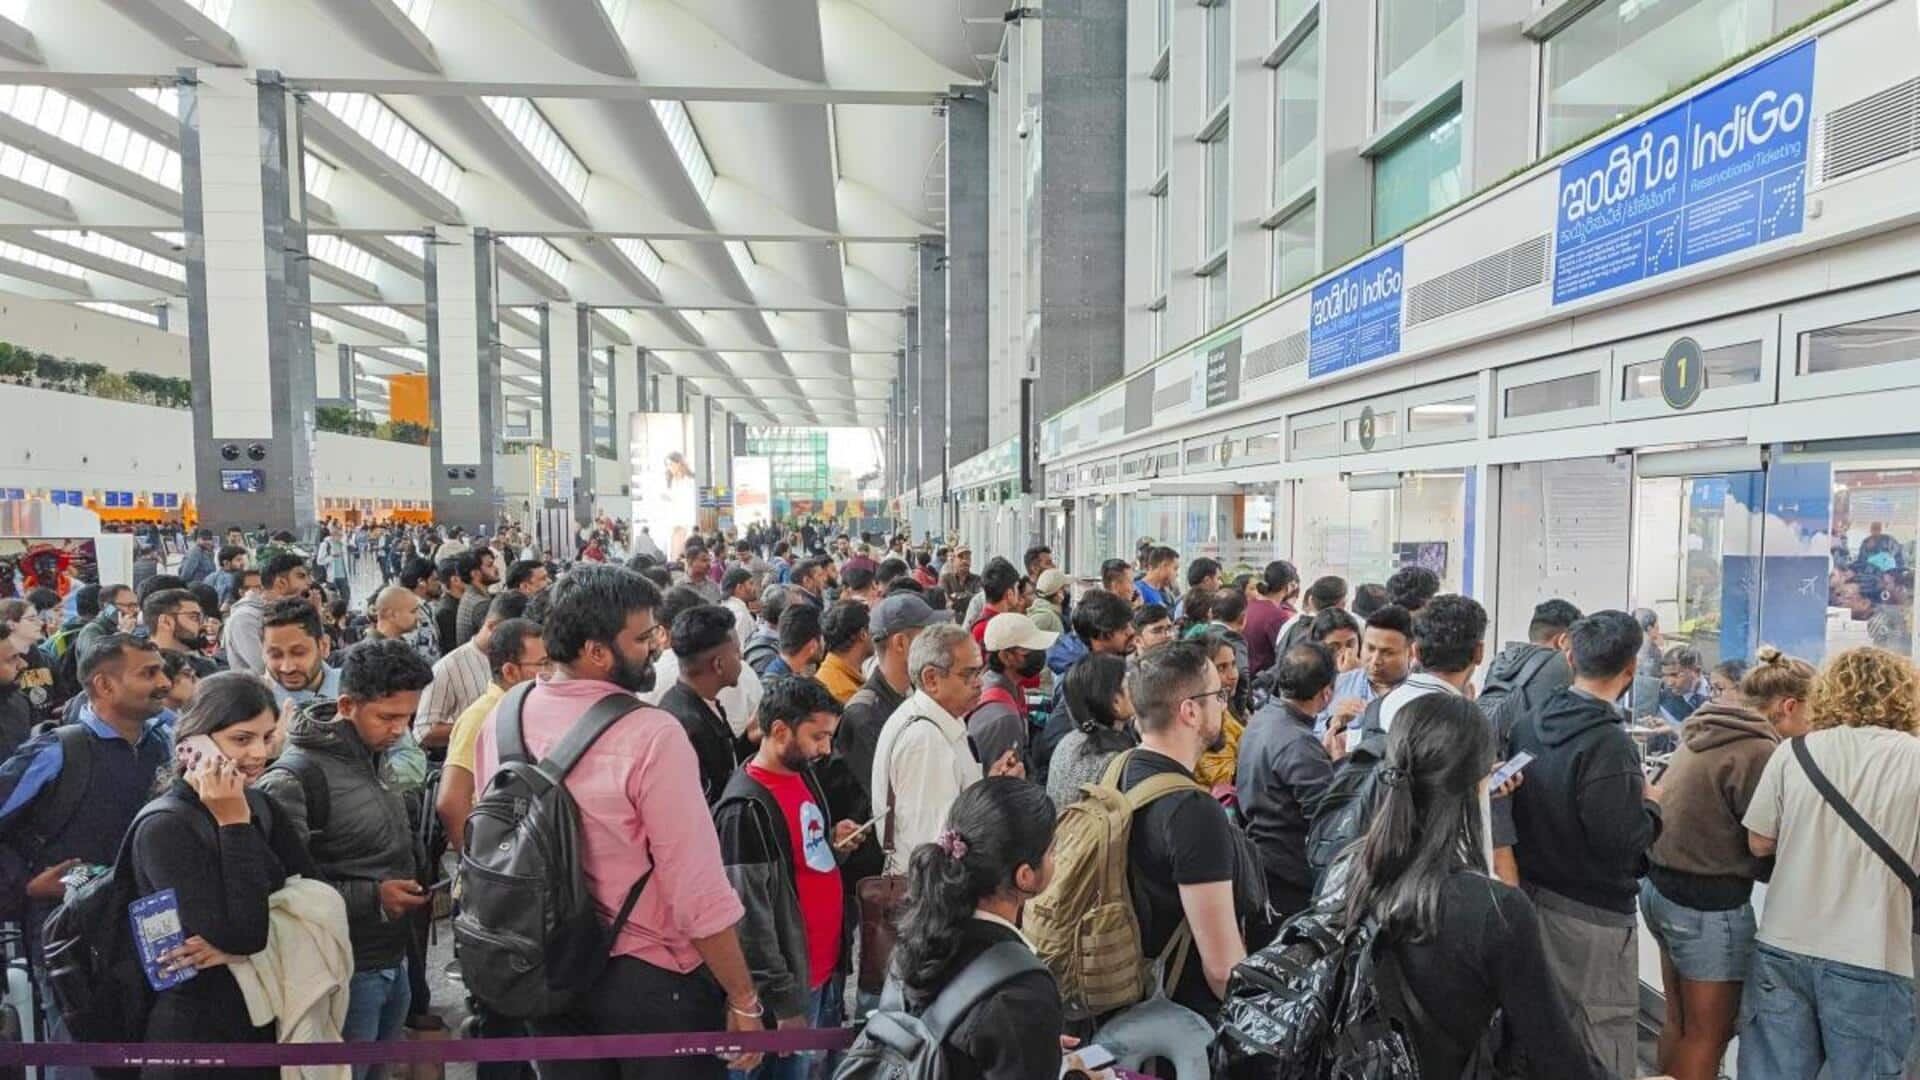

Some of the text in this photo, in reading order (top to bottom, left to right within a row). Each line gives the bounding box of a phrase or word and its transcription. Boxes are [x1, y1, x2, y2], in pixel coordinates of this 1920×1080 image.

[1693, 91, 1804, 170] IndiGo
[1363, 267, 1401, 306] IndiGo
[1677, 358, 1689, 388] 1
[1364, 419, 1370, 438] 2
